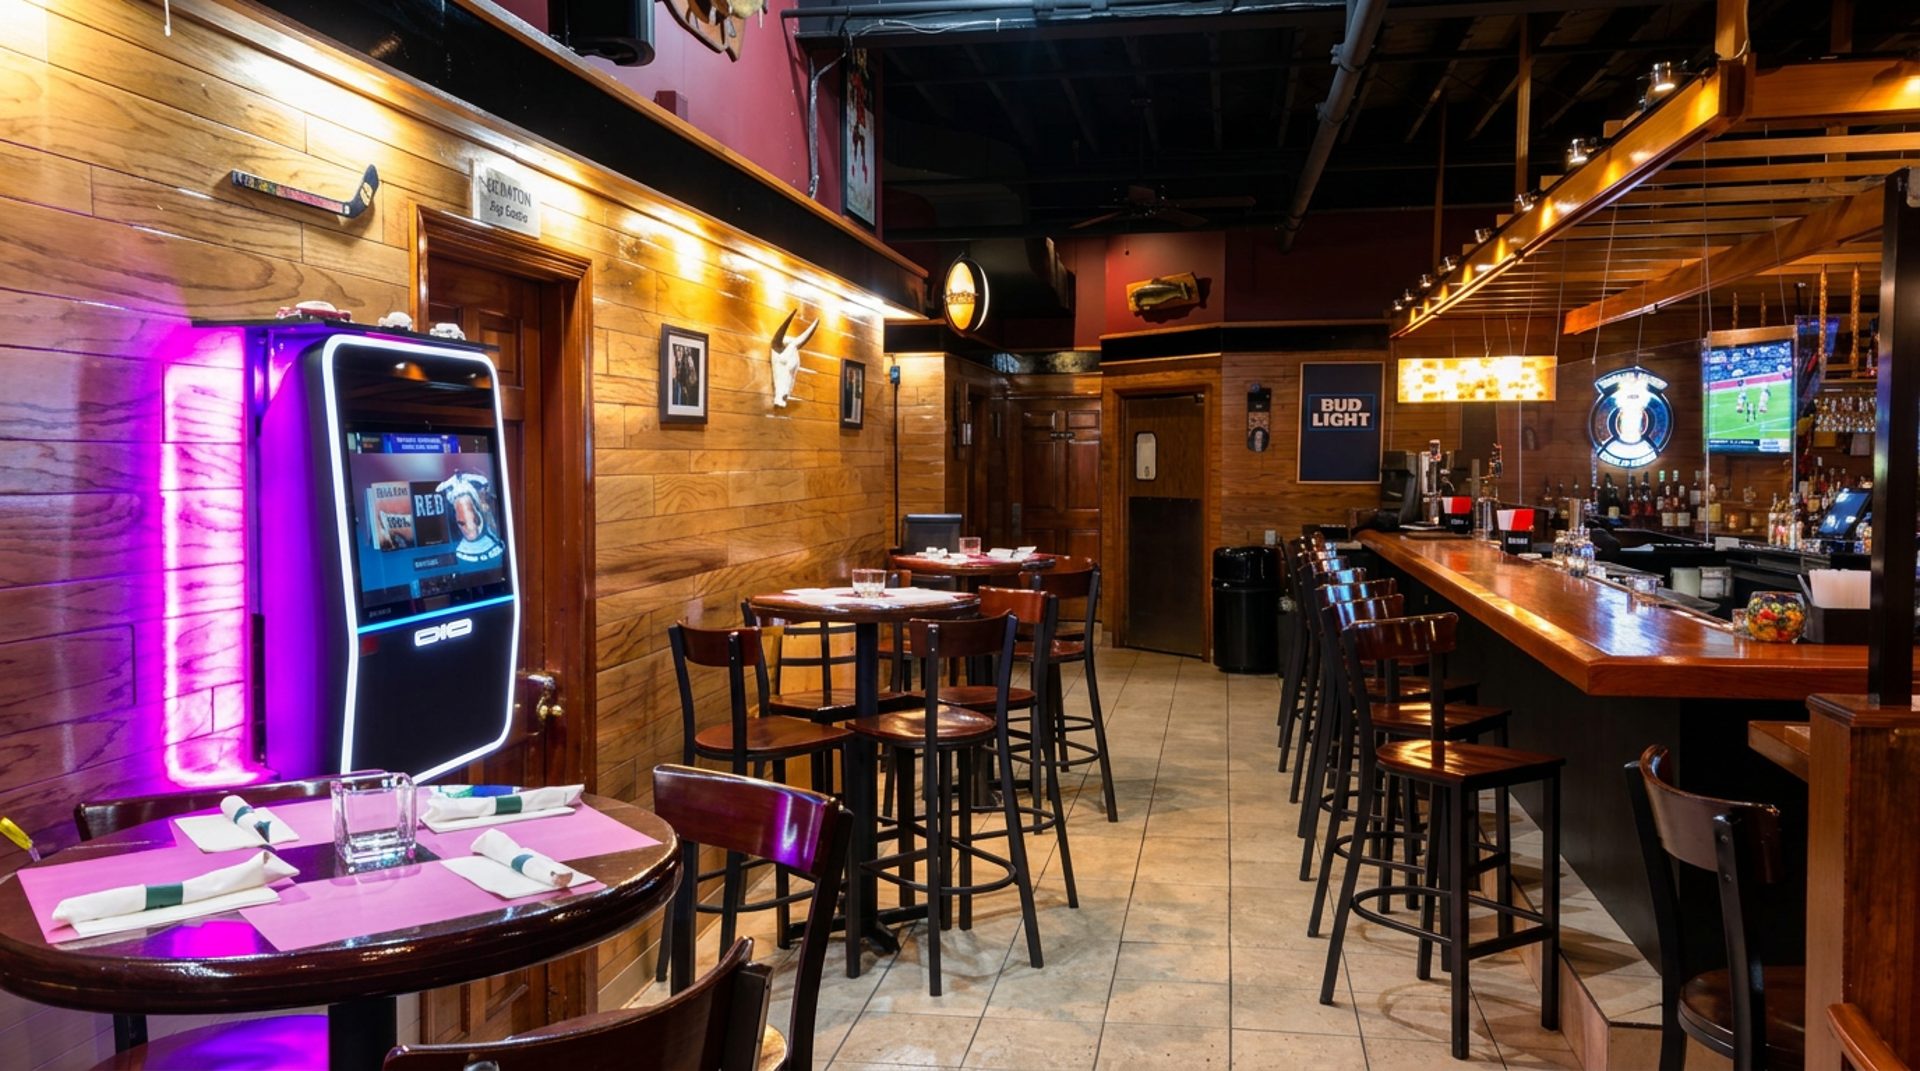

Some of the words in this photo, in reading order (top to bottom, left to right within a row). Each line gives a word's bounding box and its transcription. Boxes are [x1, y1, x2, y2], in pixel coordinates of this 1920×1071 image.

[1320, 398, 1362, 412] BUD
[1312, 412, 1371, 427] LIGHT
[413, 493, 445, 517] RED
